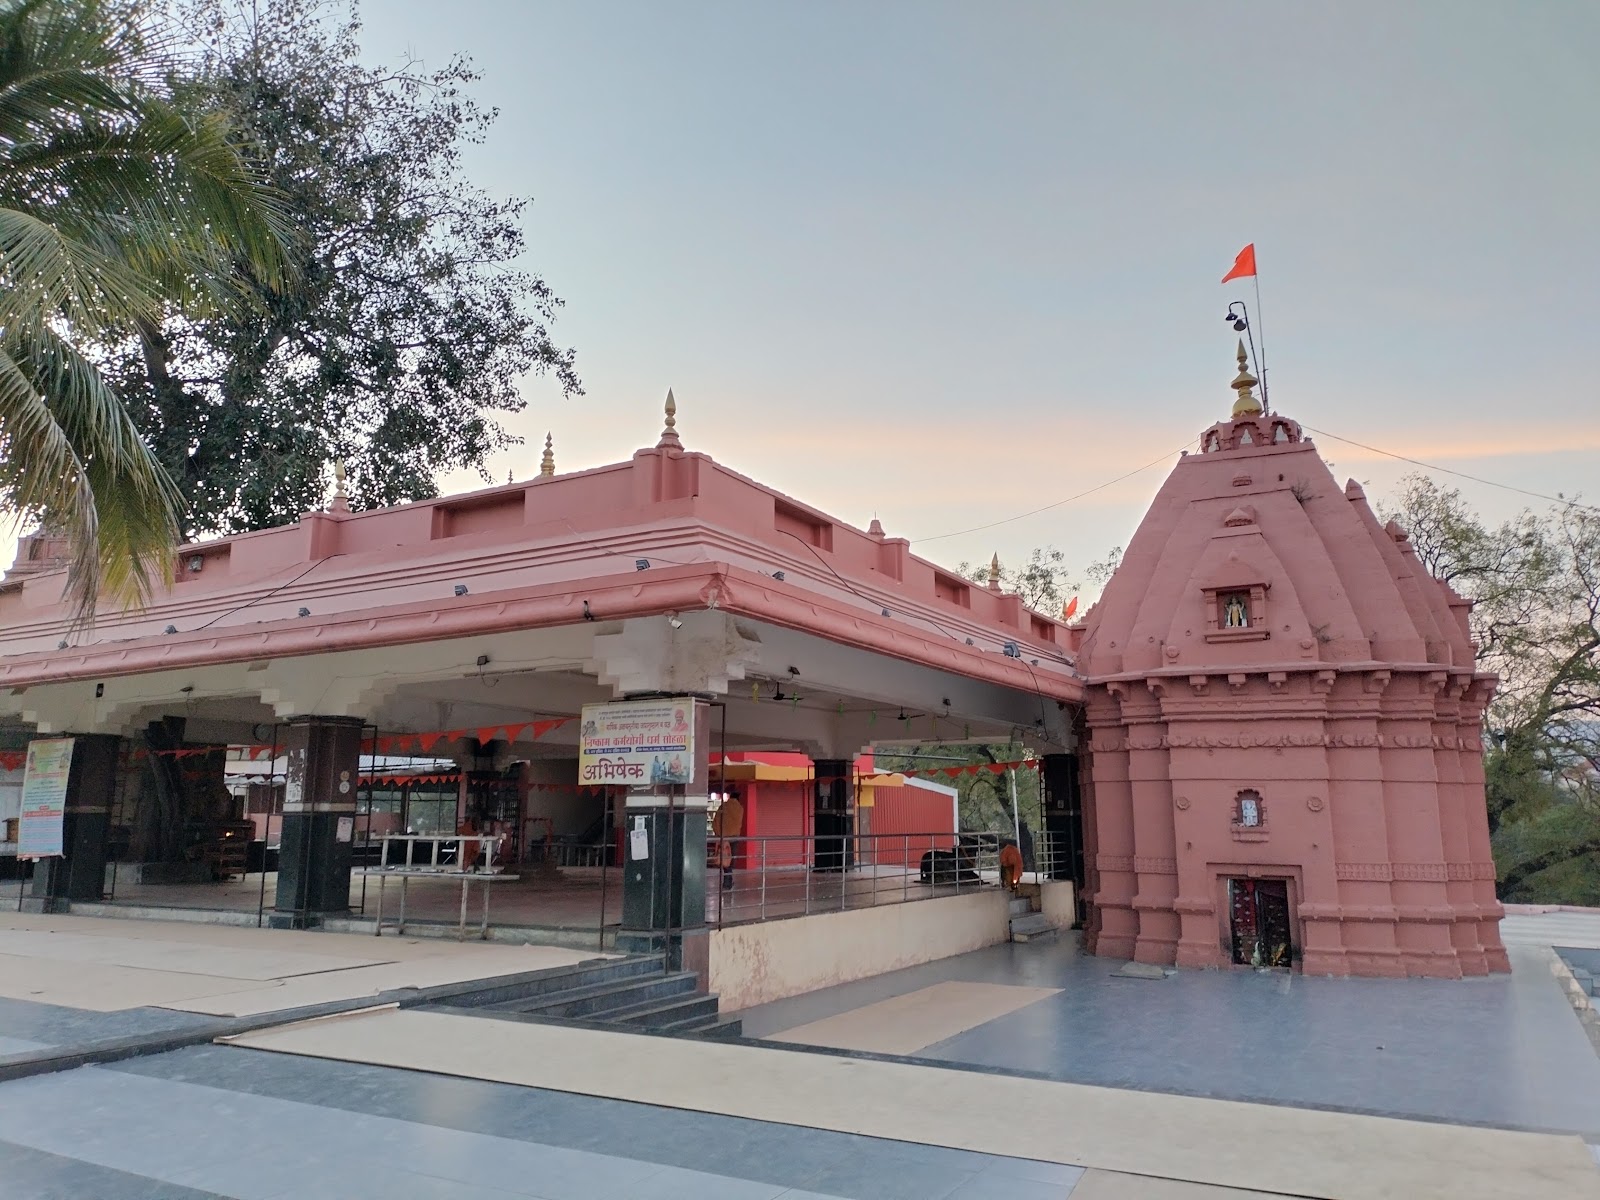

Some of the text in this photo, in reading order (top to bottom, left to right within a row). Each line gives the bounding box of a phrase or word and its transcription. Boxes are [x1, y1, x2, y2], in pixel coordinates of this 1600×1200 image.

[584, 732, 686, 747] निष्काम कर्मयोगी धर्म सोहळा
[583, 757, 645, 780] अभिषेक
